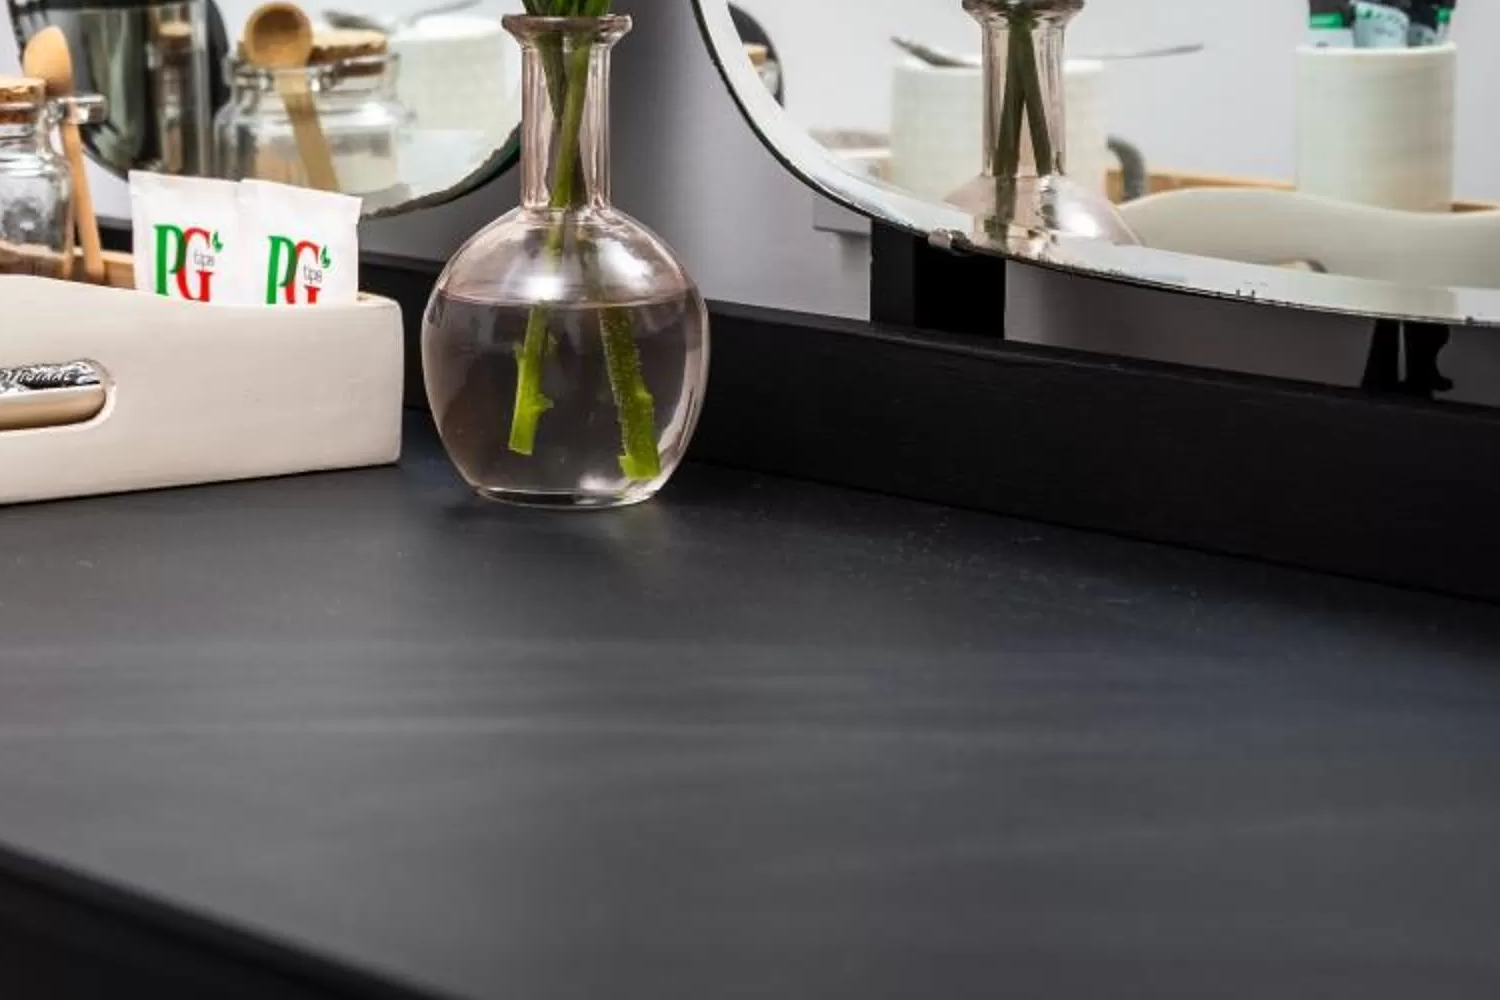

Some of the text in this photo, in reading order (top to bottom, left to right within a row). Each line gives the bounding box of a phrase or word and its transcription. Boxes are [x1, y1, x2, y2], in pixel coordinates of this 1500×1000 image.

[153, 224, 215, 302] PG tips
[267, 235, 322, 304] PG tips
